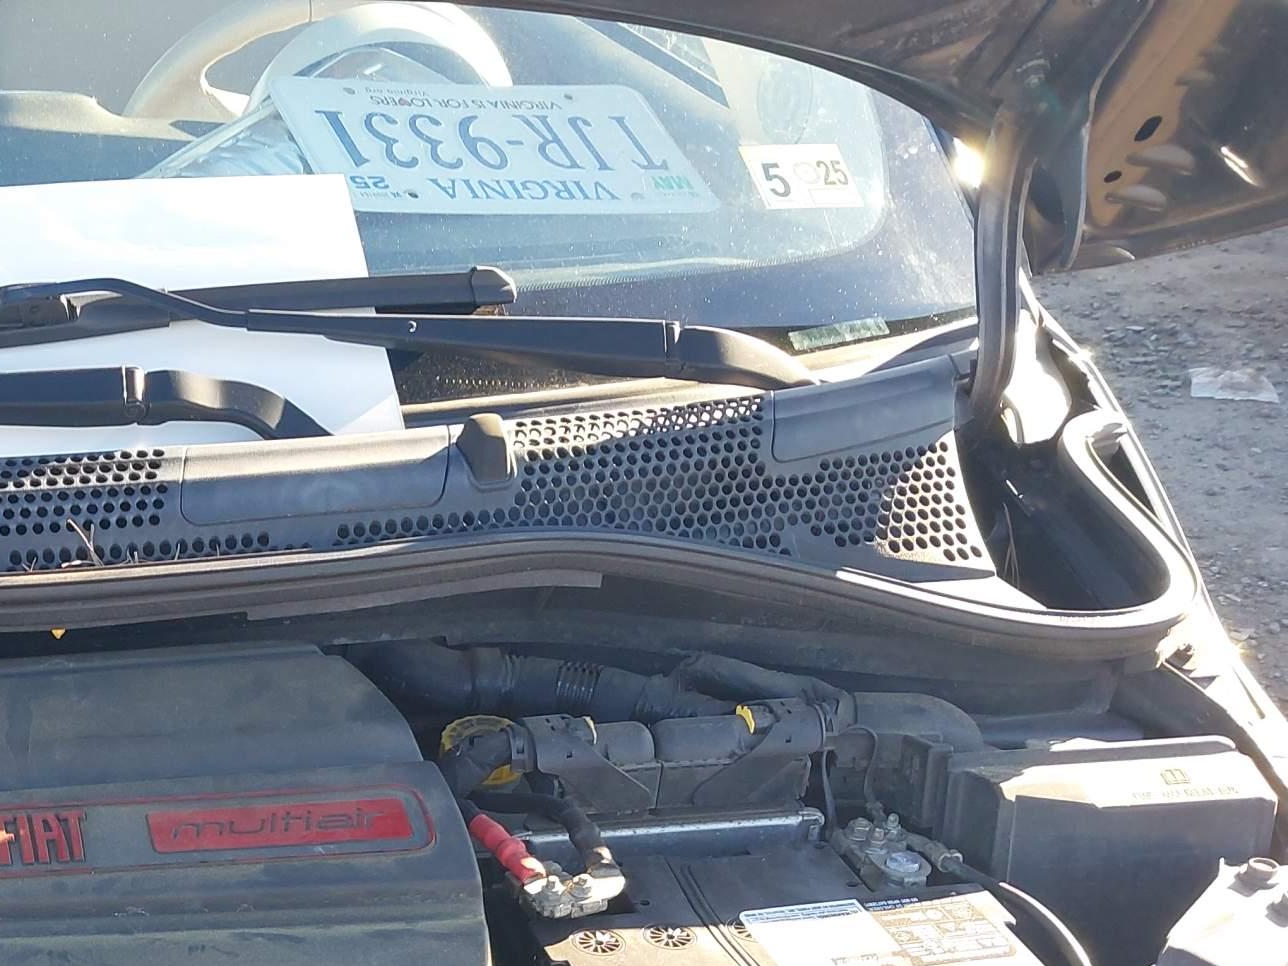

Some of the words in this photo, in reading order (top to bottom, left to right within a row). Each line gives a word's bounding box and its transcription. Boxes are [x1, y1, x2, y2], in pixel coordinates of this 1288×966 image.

[435, 98, 470, 109] FOR
[472, 99, 485, 109] IS
[487, 99, 563, 111] VIRGINIA
[314, 110, 669, 171] TJR-9331
[349, 175, 390, 190] 25
[650, 176, 694, 190] MAY
[761, 162, 791, 198] 5
[815, 160, 849, 186] 25
[428, 177, 622, 201] VIRGINIA
[171, 805, 386, 841] multiair
